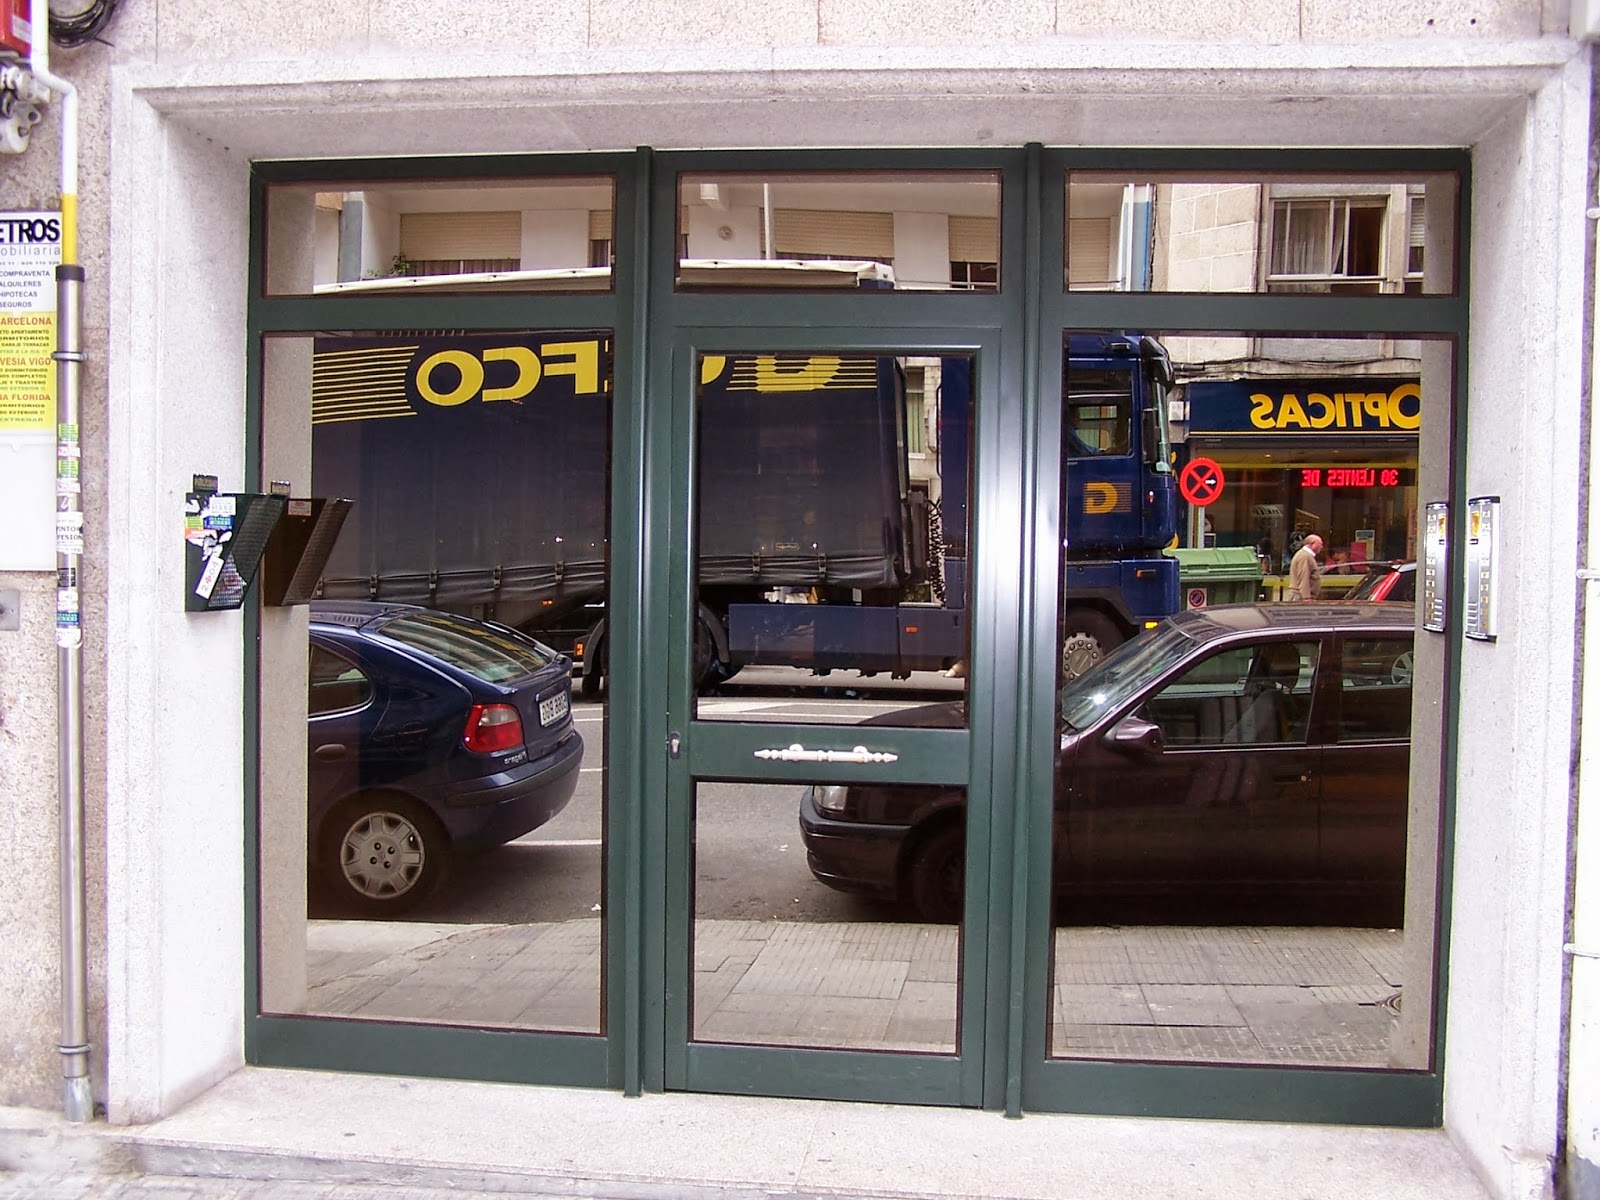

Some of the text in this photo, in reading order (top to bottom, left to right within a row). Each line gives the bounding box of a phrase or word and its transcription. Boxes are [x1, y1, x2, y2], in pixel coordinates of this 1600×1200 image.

[0, 317, 52, 326] ARCELONA
[29, 357, 52, 366] VIGO
[11, 393, 51, 401] FLORIDA
